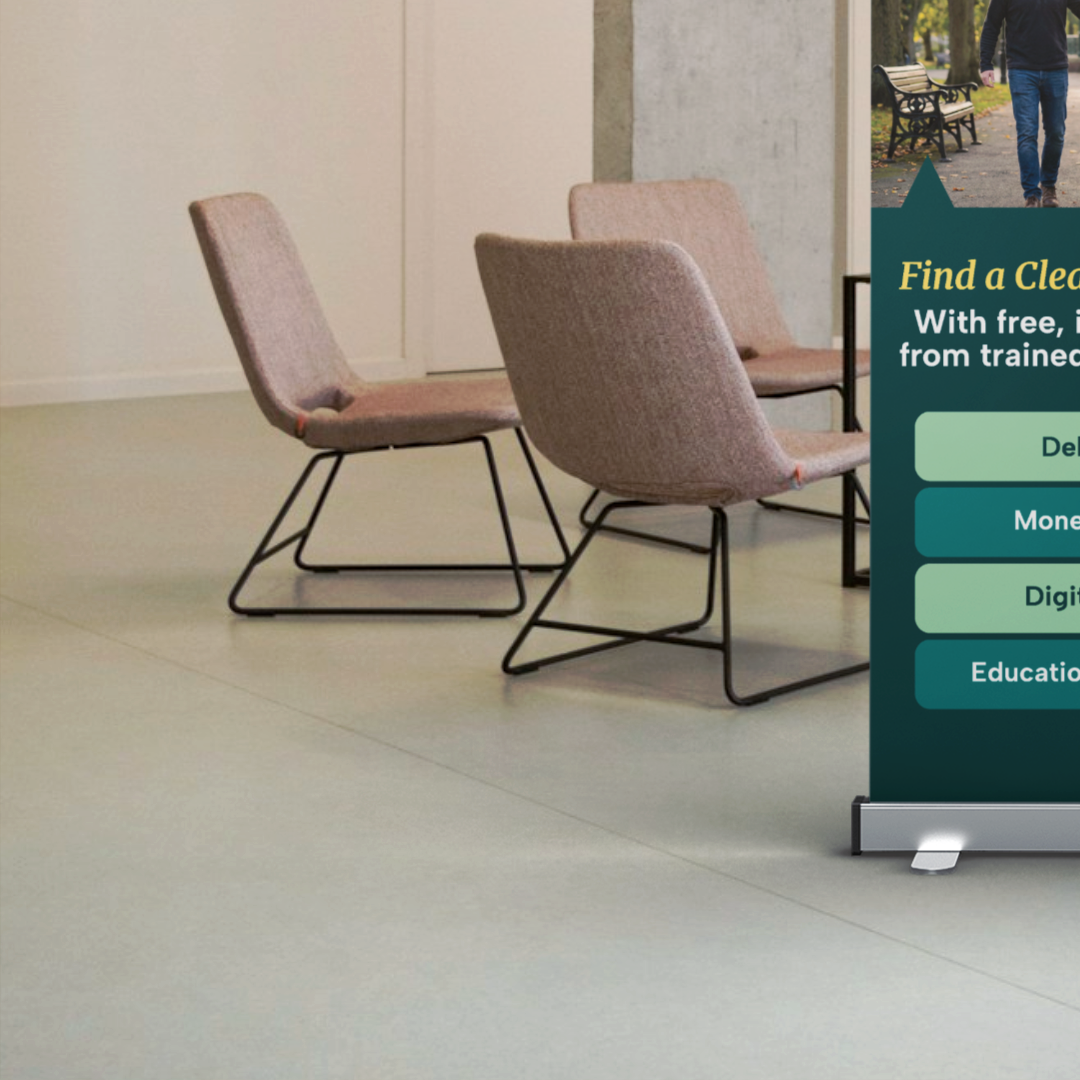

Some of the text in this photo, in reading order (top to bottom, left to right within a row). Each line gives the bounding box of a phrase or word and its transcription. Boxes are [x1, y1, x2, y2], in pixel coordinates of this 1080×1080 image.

[899, 259, 976, 290] Find
[985, 268, 1005, 290] a
[914, 309, 986, 334] With
[997, 309, 1063, 338] free,
[900, 342, 969, 367] from
